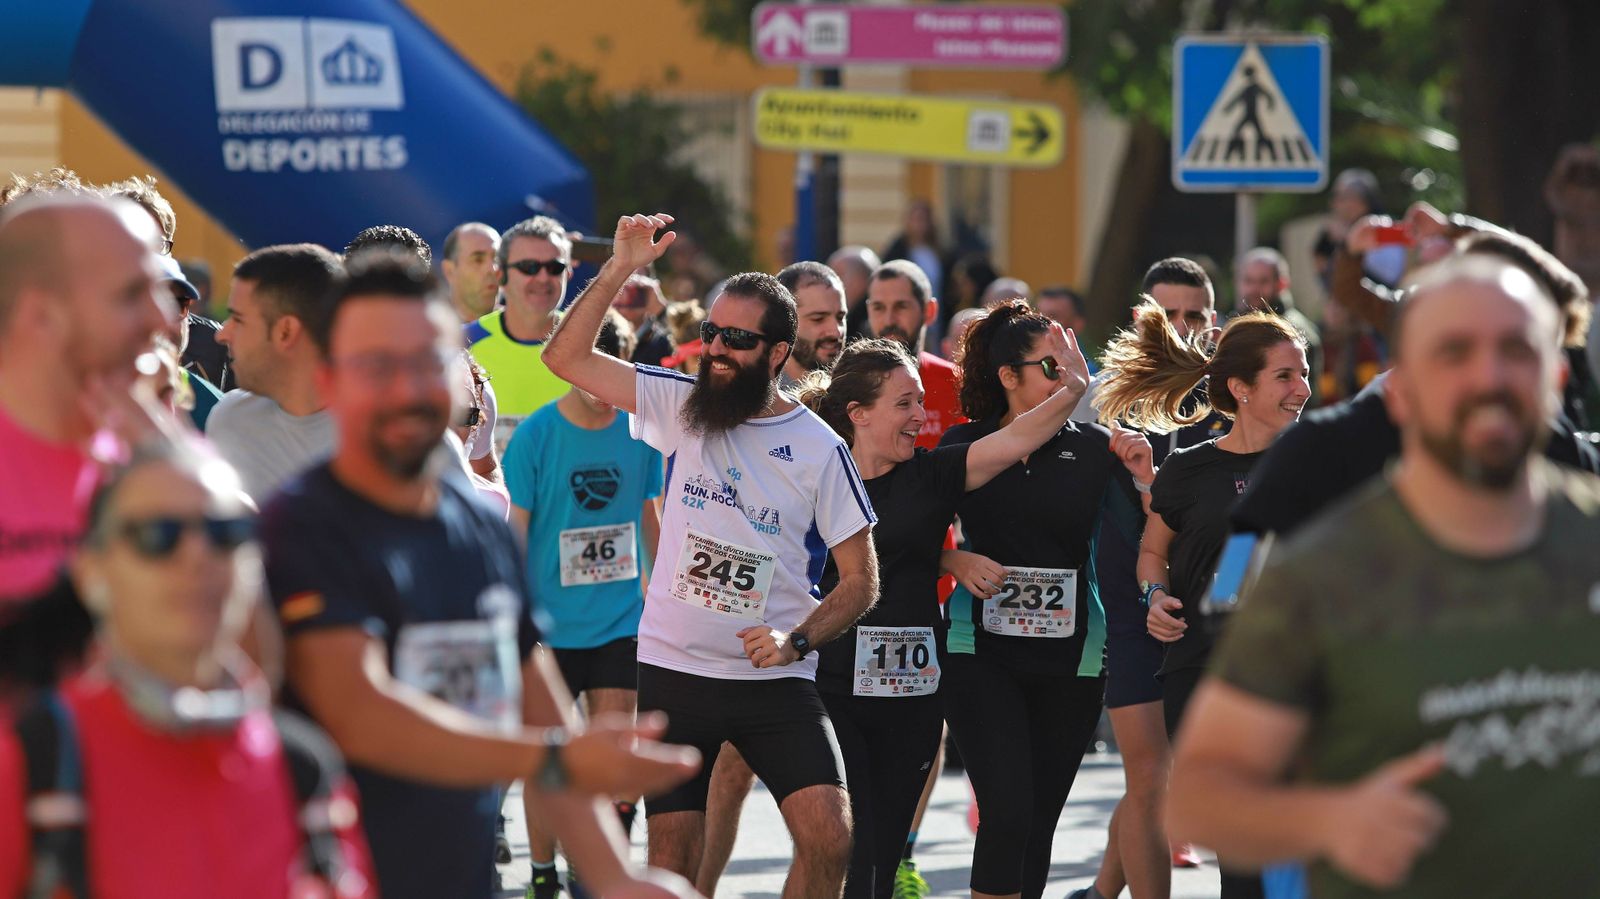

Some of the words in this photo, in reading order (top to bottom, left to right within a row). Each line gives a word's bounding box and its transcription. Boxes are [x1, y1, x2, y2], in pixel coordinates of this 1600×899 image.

[239, 43, 283, 90] D
[342, 112, 372, 131] DE
[761, 98, 919, 122] Ayuntamiento
[222, 135, 408, 171] DEPORTES
[768, 450, 793, 462] adidas
[681, 495, 706, 510] 42K
[683, 483, 709, 499] RUN.
[749, 520, 782, 536] DRID!
[582, 539, 616, 562] 46
[694, 543, 715, 554] ENTRE
[714, 548, 727, 557] DOS
[728, 553, 761, 566] CIUDADES
[695, 536, 722, 550] CARRERA
[723, 545, 745, 556] CÍVICO
[744, 552, 773, 562] MILITAR
[689, 551, 757, 591] 245
[1000, 583, 1064, 610] 232
[873, 643, 929, 670] 110
